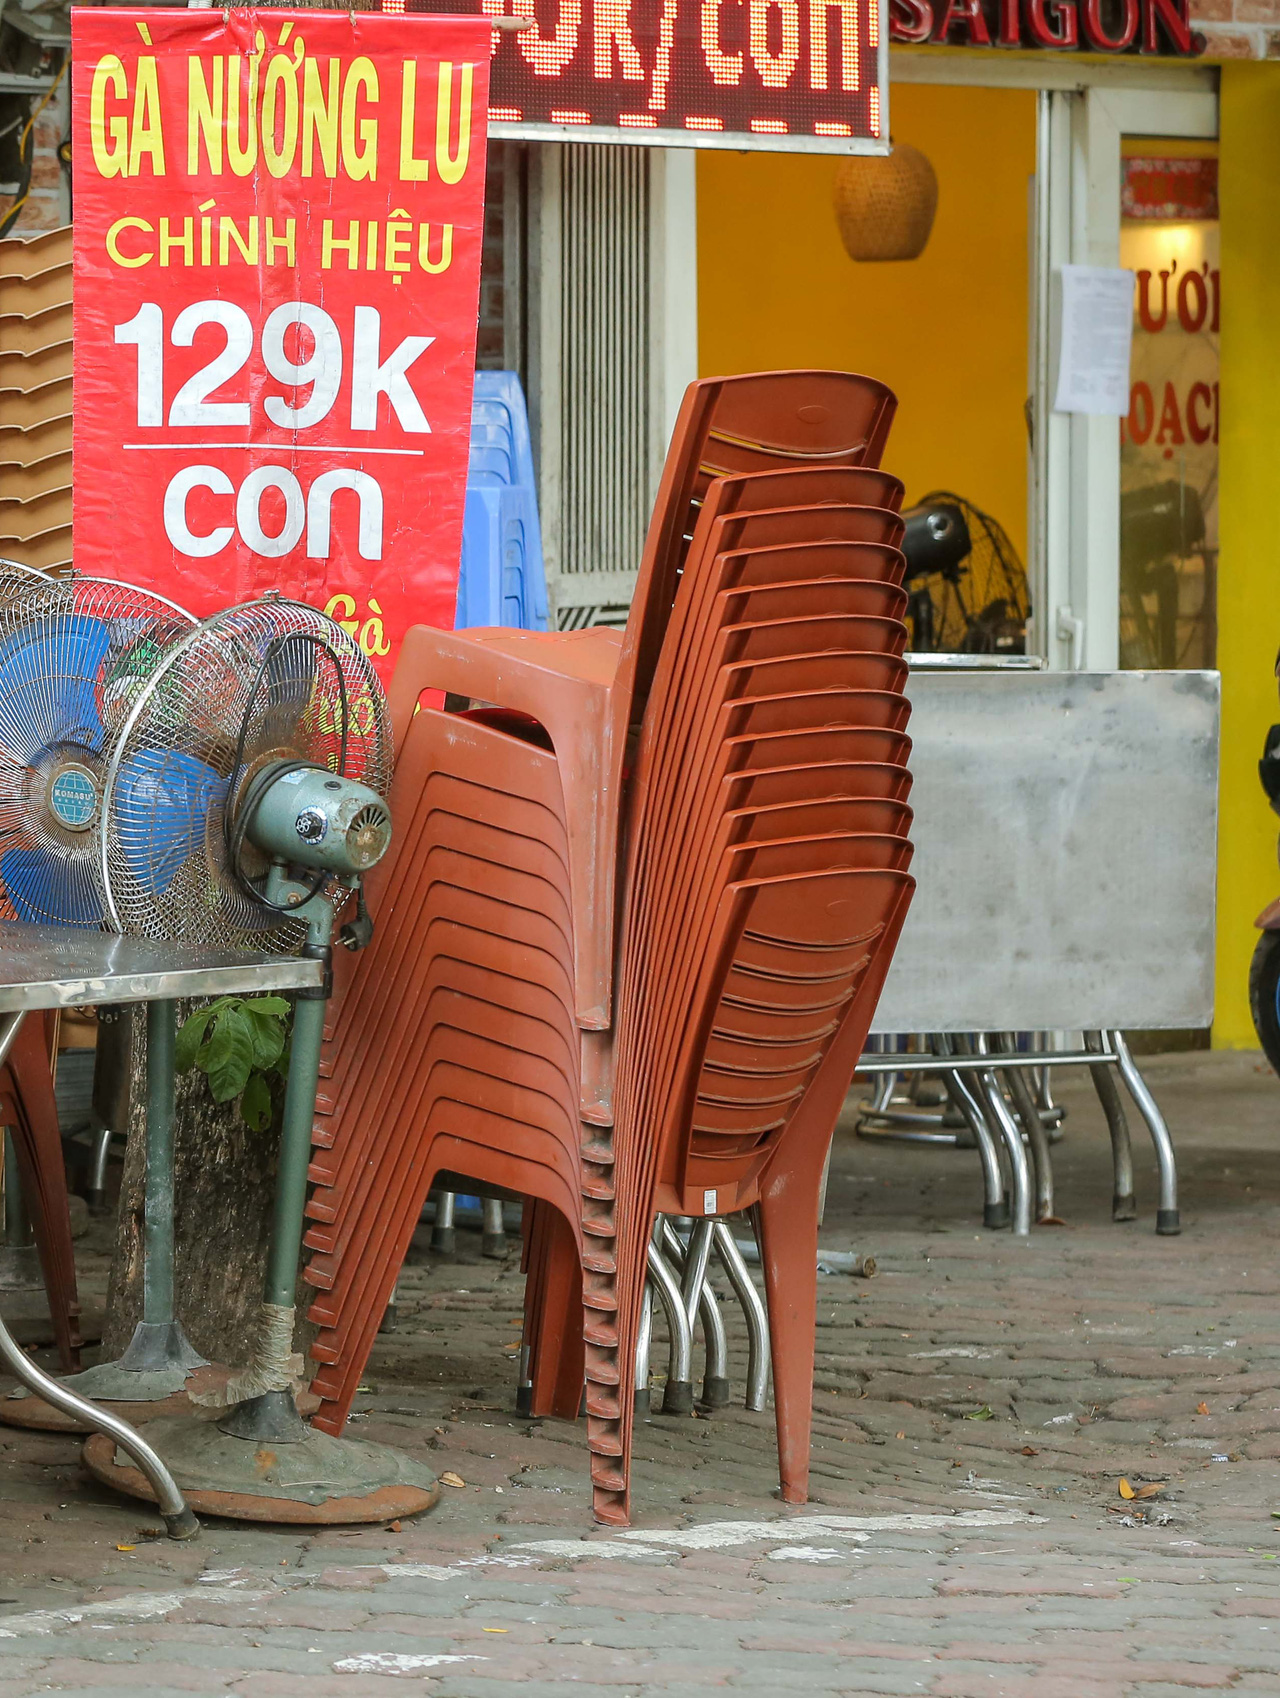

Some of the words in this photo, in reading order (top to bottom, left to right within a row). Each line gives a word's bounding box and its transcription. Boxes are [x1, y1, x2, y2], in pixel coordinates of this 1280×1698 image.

[90, 22, 166, 179] GÀ
[187, 22, 380, 182] NƯỚNG
[399, 60, 474, 185] LU
[105, 198, 297, 269] CHÍNH
[321, 208, 454, 284] HIỆU
[114, 300, 437, 434] 129k
[163, 465, 384, 561] con
